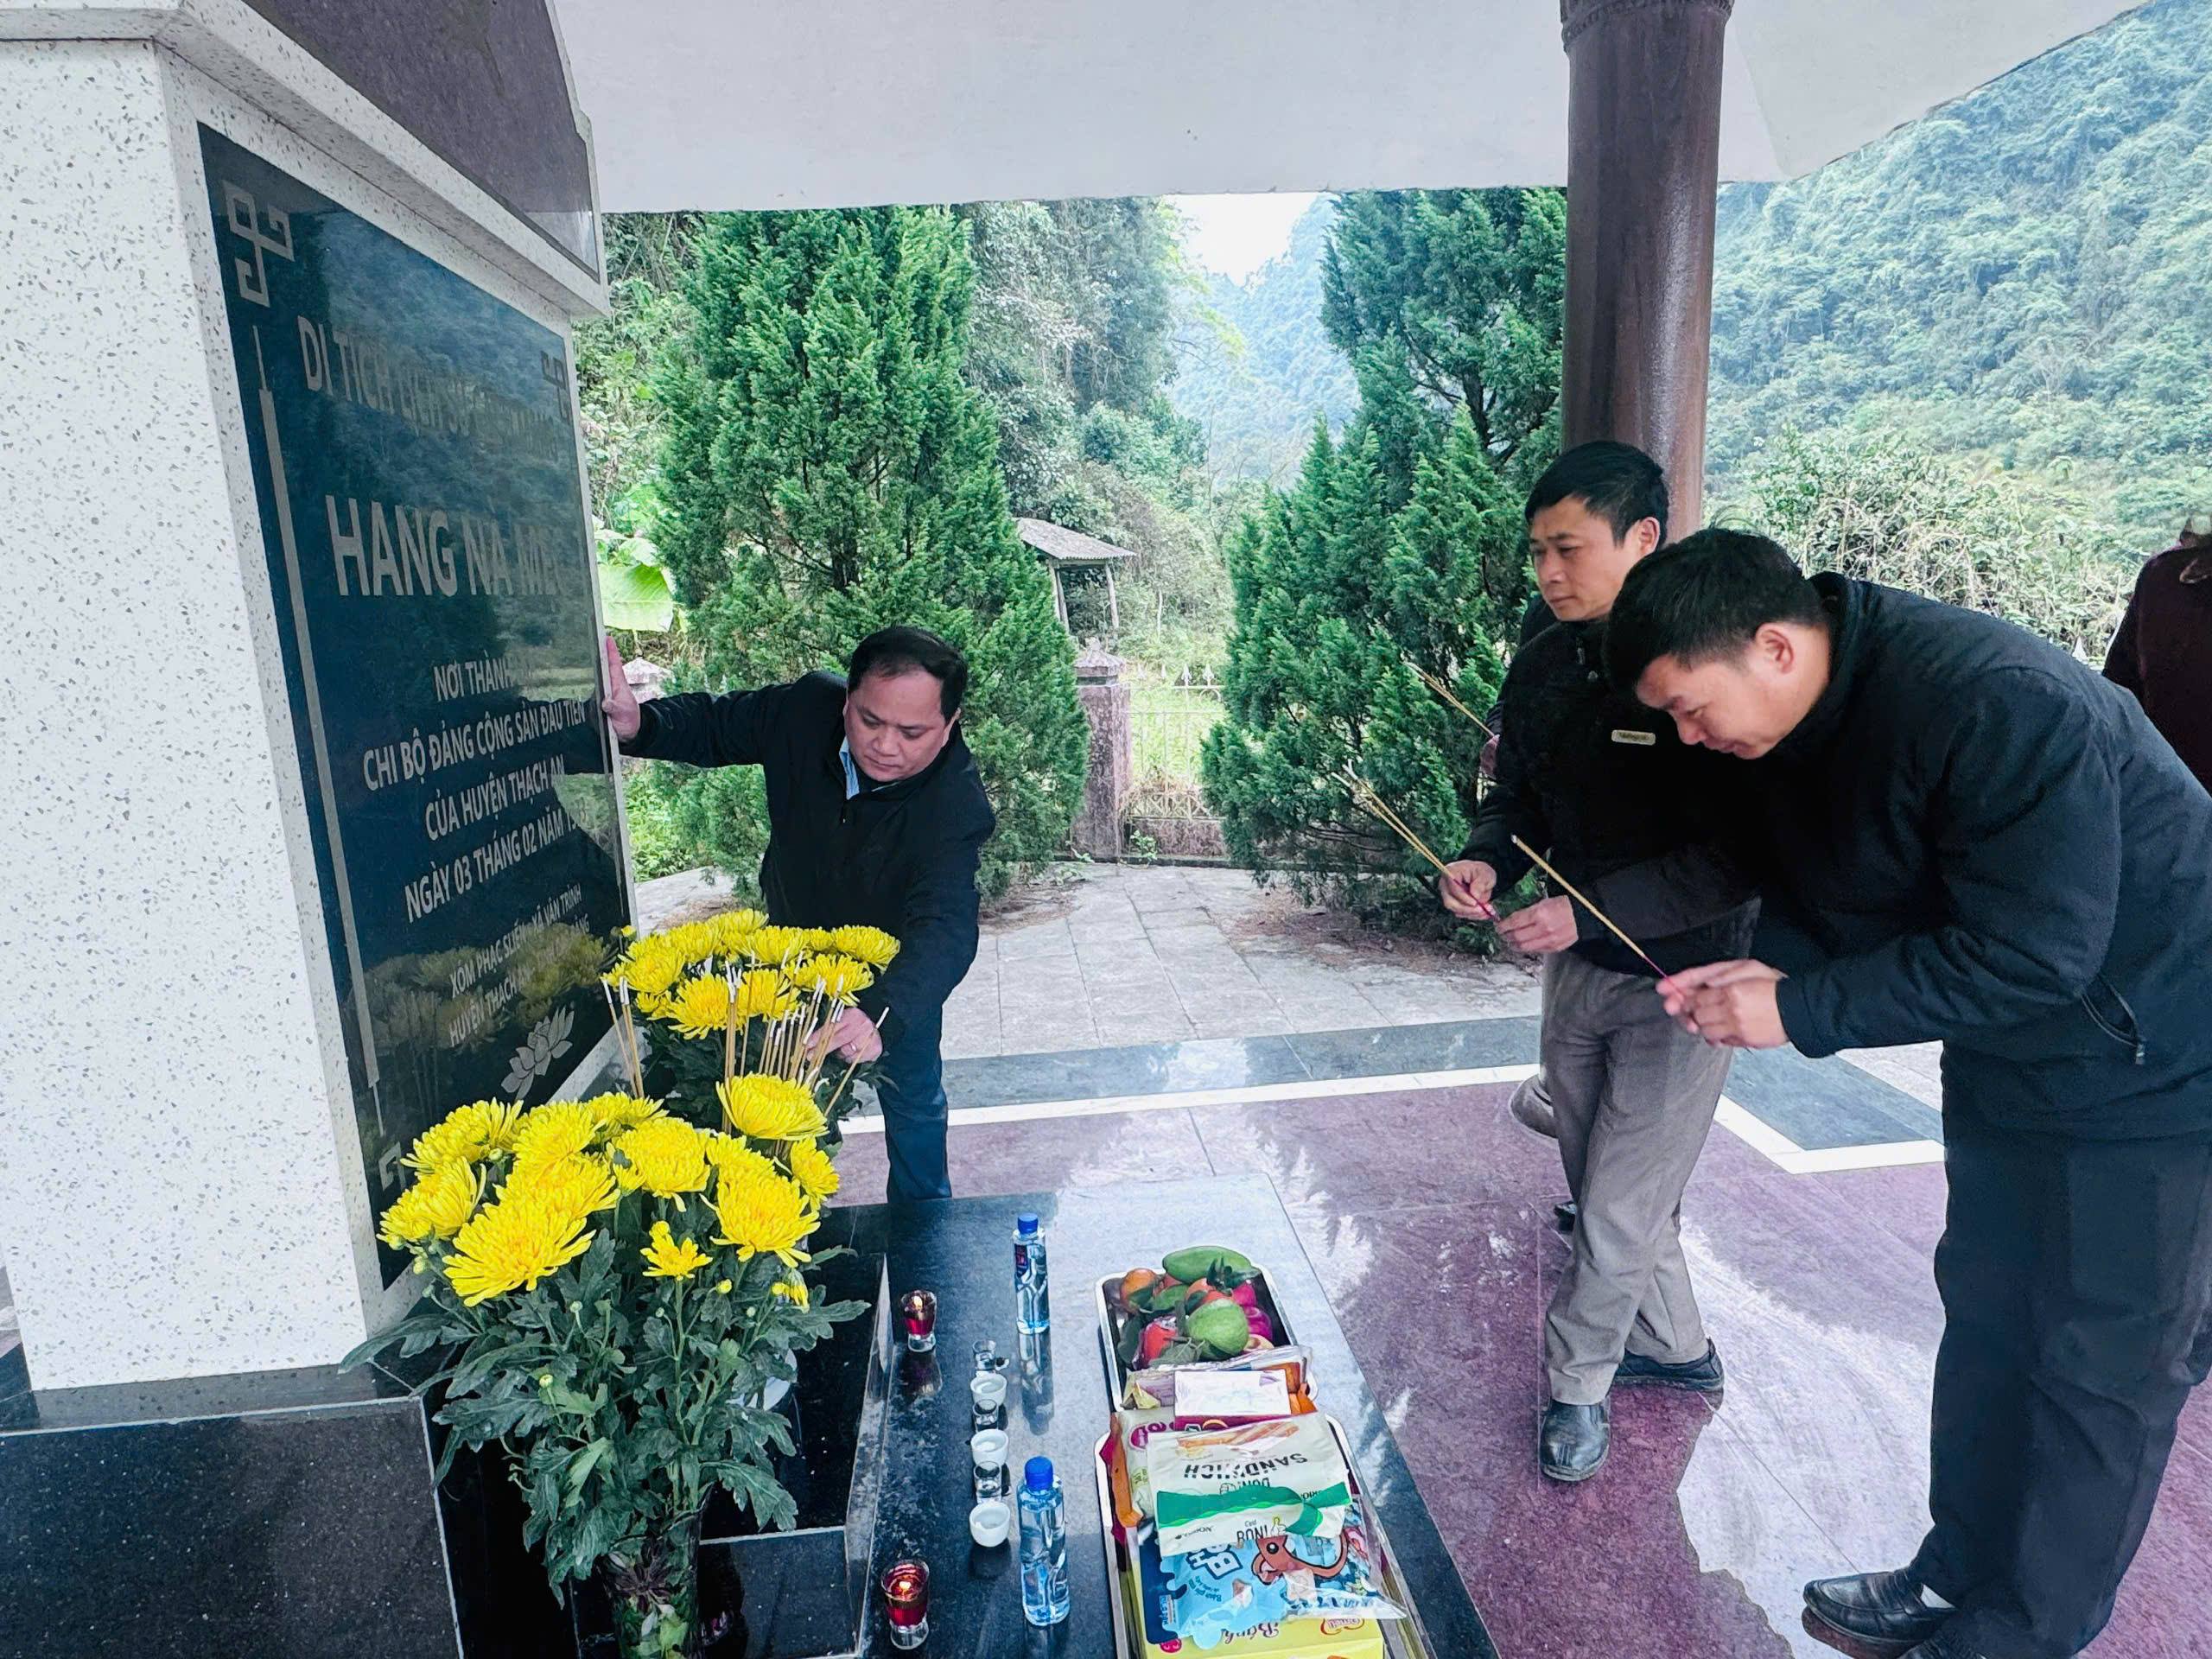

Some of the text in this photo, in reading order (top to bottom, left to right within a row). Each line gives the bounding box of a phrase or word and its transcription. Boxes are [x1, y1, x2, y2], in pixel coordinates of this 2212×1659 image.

[297, 315, 334, 396] DI
[325, 493, 458, 597] HANG
[461, 495, 514, 595] NÀ
[434, 660, 465, 702] NƠI
[465, 649, 515, 695] THÀNH
[363, 745, 400, 791] CHI
[400, 728, 427, 784] BỘ
[429, 719, 475, 772] ĐẢNG
[476, 710, 514, 760] CỘNG
[515, 699, 540, 744] SẢN
[425, 787, 461, 842] CỦA
[461, 772, 508, 826] HUYỆN
[508, 763, 551, 806] THẠCH
[404, 861, 451, 925] NGÀY
[453, 855, 474, 894] 03
[474, 830, 522, 887] THÁNG
[522, 823, 538, 857] 02
[537, 804, 564, 849] NĂM
